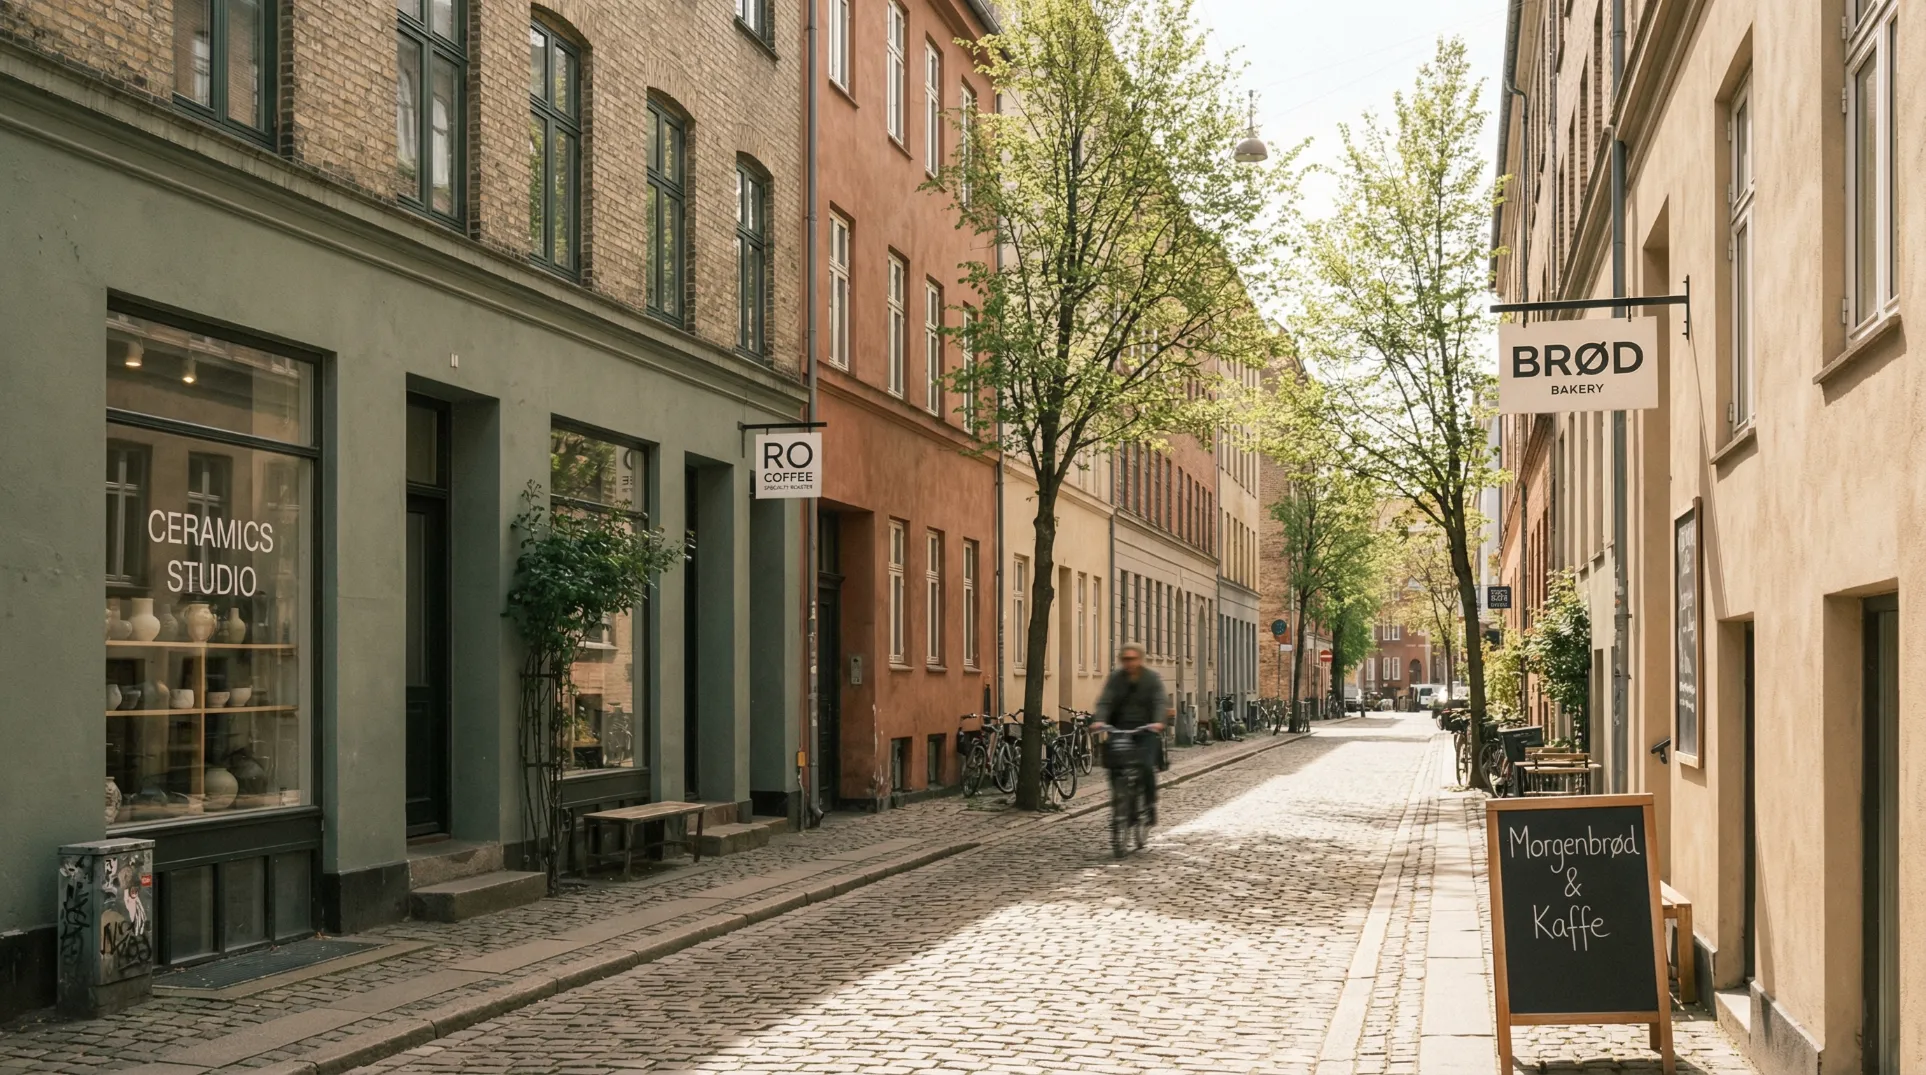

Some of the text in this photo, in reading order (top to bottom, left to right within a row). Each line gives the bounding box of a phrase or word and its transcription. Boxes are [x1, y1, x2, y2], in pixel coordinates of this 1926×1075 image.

[1512, 341, 1644, 378] BRØD
[1551, 383, 1604, 395] BAKERY
[764, 441, 813, 469] RO
[764, 471, 813, 483] COFFEE
[148, 509, 274, 553] CERAMICS
[167, 559, 257, 597] STUDIO
[1509, 825, 1640, 874] Morgenbrød
[1564, 867, 1582, 897] &
[1533, 904, 1611, 951] Kaffe
